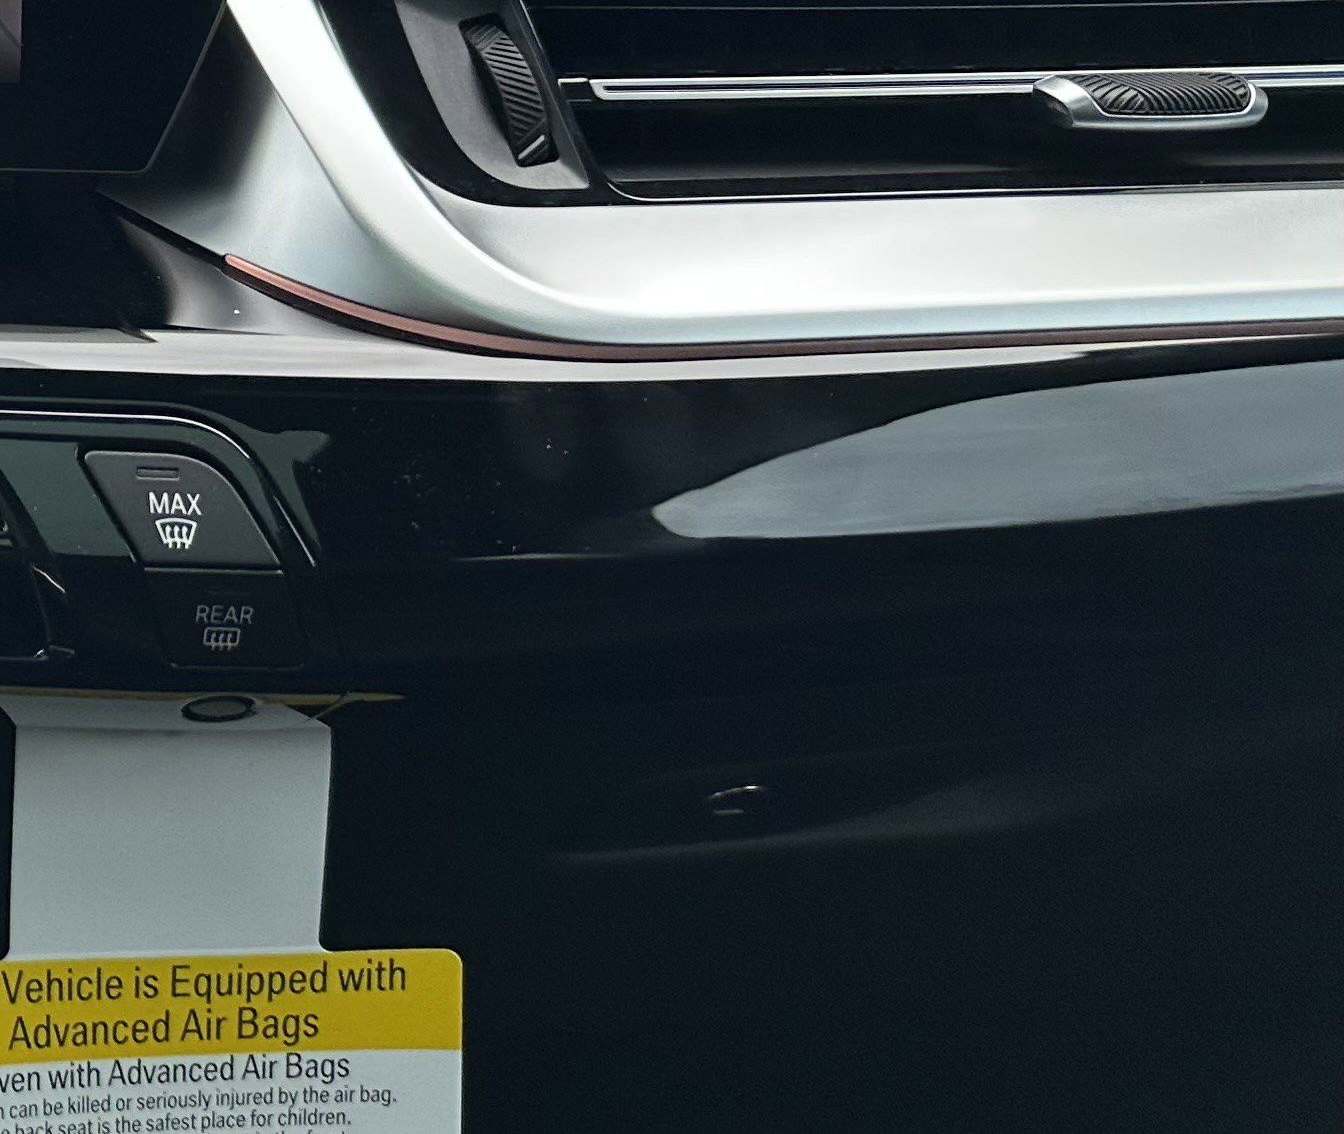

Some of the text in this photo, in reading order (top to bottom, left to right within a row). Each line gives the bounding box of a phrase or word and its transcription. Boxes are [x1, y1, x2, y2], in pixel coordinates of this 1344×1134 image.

[148, 491, 202, 516] MAX
[195, 604, 255, 624] REAR
[1, 967, 124, 1005] Vehicle
[134, 966, 160, 999] is
[171, 960, 328, 1004] Equipped
[338, 957, 406, 992] with
[8, 1006, 320, 1050] Advanced Air Bags
[48, 1061, 100, 1089] with
[107, 1054, 234, 1086] Advanced
[241, 1053, 278, 1080] Air
[286, 1052, 350, 1084] Bags
[9, 1101, 38, 1118] can
[43, 1098, 63, 1116] be
[67, 1094, 111, 1115] killed
[115, 1095, 133, 1111] or
[136, 1089, 211, 1112] seriously
[215, 1086, 273, 1110] injured
[278, 1086, 299, 1108] by
[302, 1086, 329, 1104] the
[334, 1085, 354, 1103] air
[360, 1084, 397, 1107] bag.
[14, 1108, 351, 1134] back seat is the safest place for children.
